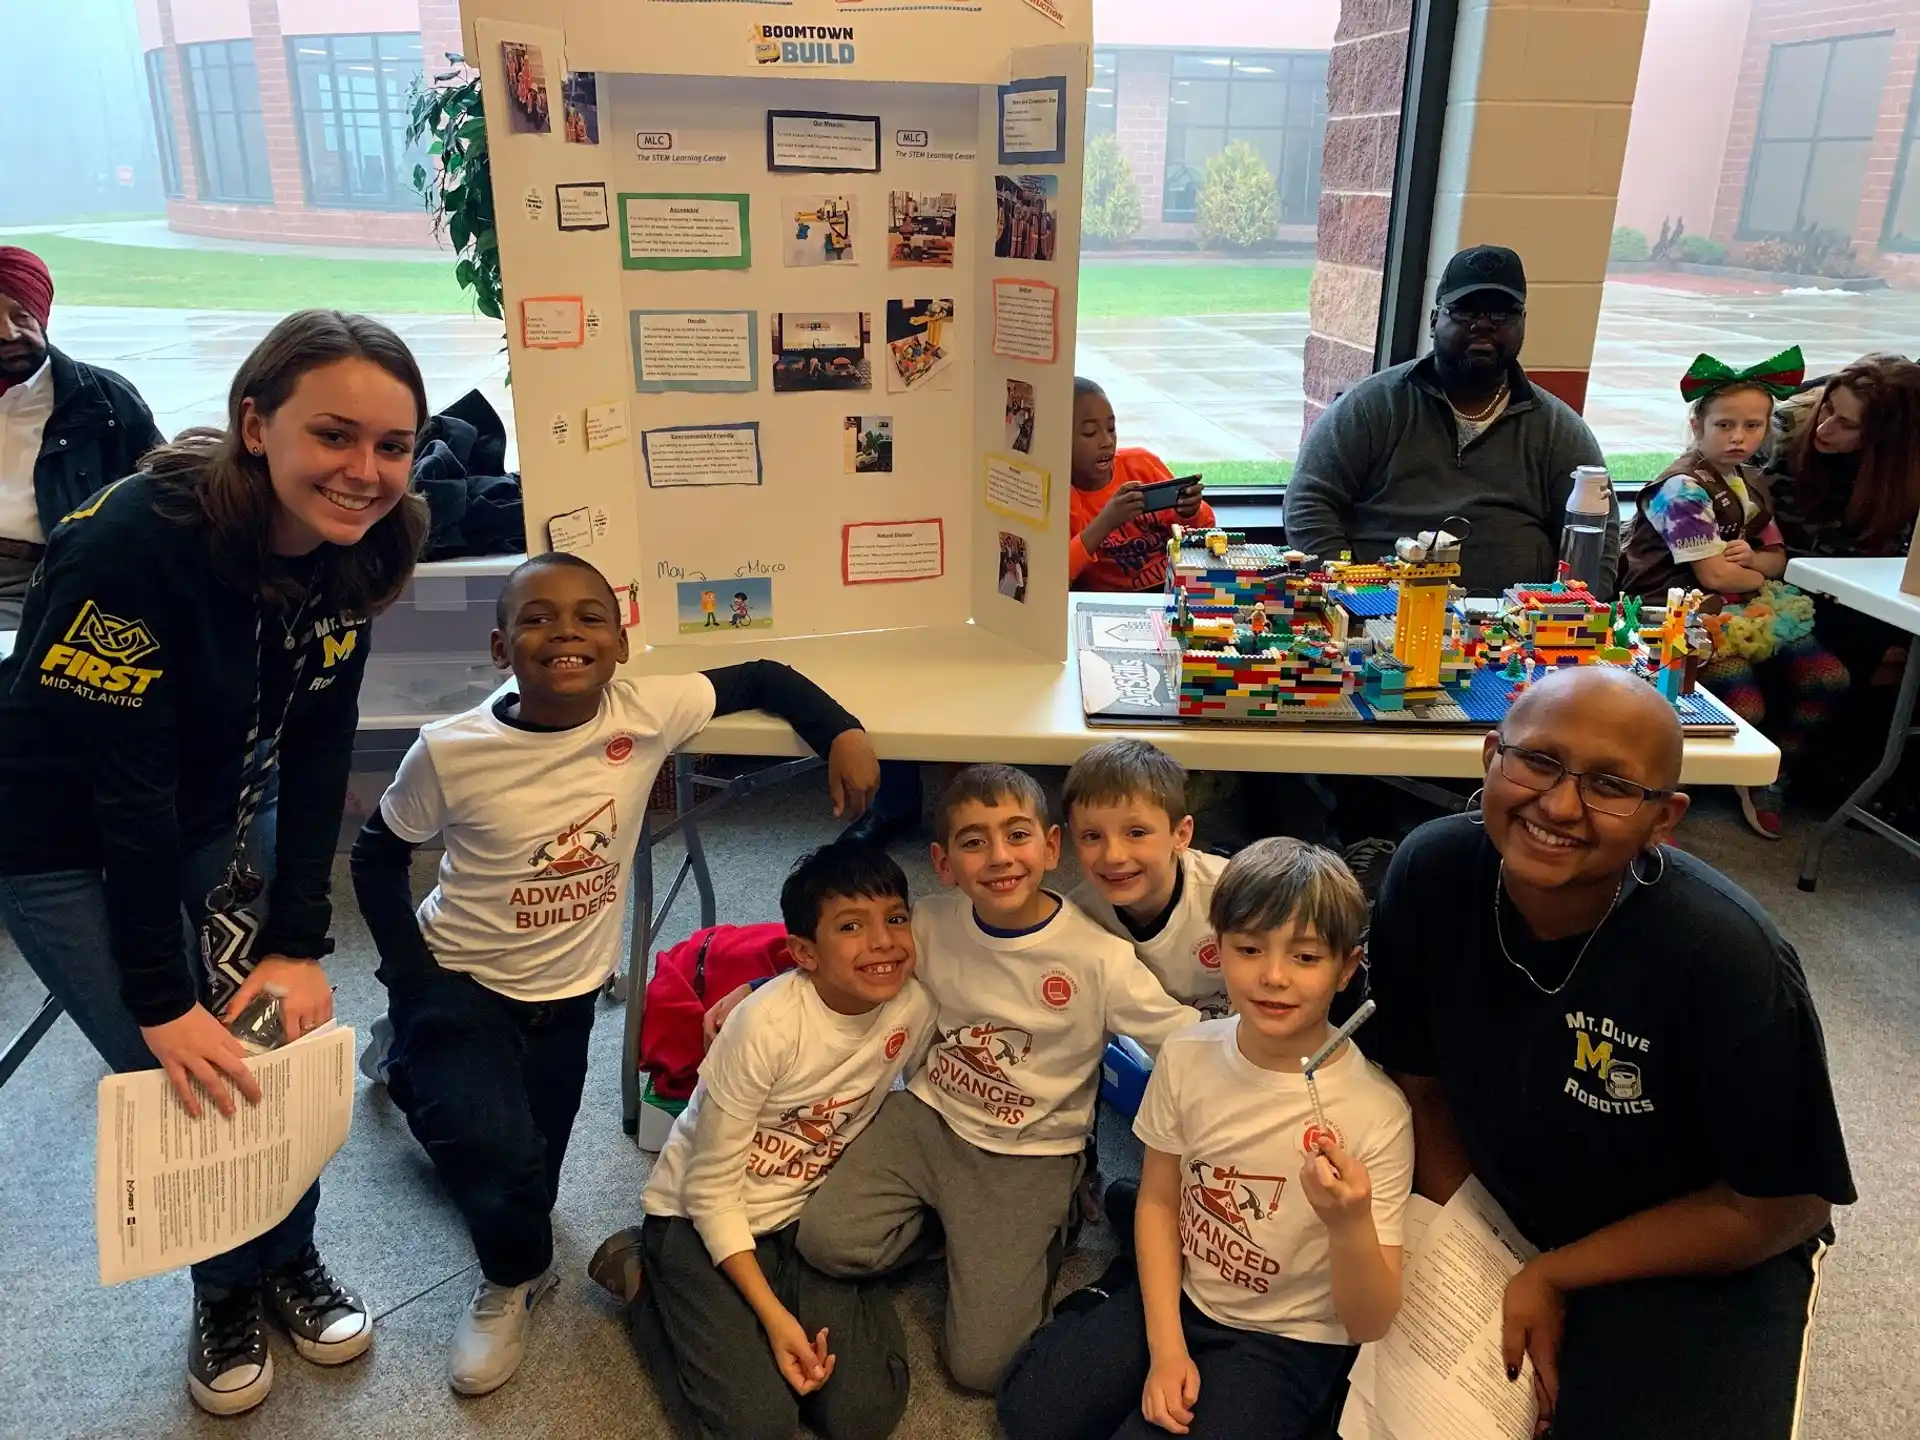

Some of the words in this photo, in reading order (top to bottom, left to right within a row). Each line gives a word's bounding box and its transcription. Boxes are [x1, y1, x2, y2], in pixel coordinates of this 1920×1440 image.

[762, 25, 854, 40] BOOMTOWN
[781, 42, 855, 64] BUILD
[644, 136, 664, 145] MLC
[903, 133, 921, 142] MLC
[672, 154, 702, 163] Learning
[926, 152, 953, 160] Learning
[954, 152, 976, 160] Center
[657, 560, 685, 580] May
[748, 559, 786, 575] Marco
[323, 629, 357, 668] M
[40, 643, 164, 694] FIRST
[1111, 658, 1164, 707] ArtSkills
[40, 674, 144, 708] MID-ATLANTIC
[508, 863, 621, 906] ADVANCED
[515, 884, 618, 929] BUILDERS
[1601, 1017, 1651, 1053] OLIVE
[1574, 1030, 1613, 1080] M
[1564, 1077, 1655, 1115] ROBOTICS
[1182, 1187, 1281, 1276] ADVANCED
[1180, 1210, 1270, 1294] BUILDERS
